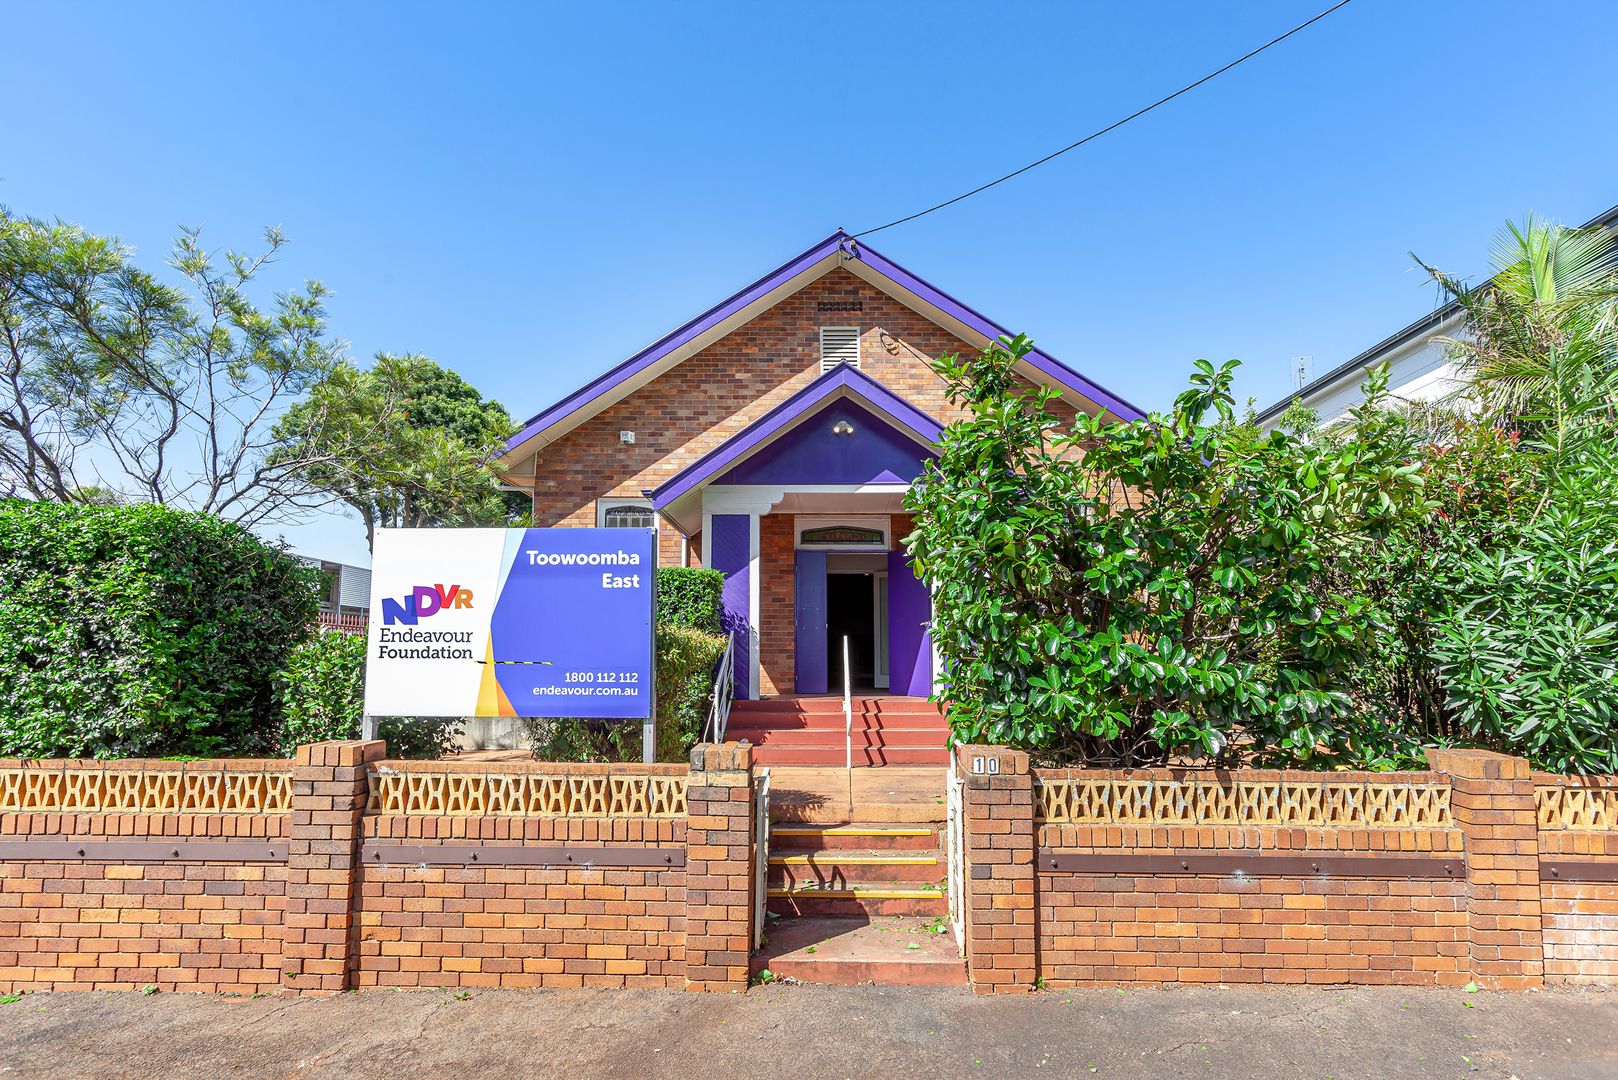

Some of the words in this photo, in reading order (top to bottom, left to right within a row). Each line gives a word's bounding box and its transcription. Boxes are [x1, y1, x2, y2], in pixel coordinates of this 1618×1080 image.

[525, 549, 640, 565] Toowoomba
[602, 573, 640, 588] East
[381, 583, 474, 625] NDVR
[379, 628, 473, 642] Endeavour
[378, 646, 473, 659] Foundation
[565, 672, 594, 683] 1800
[596, 672, 616, 683] 112
[619, 672, 639, 683] 112
[532, 685, 639, 696] endeavour.com.au
[976, 758, 997, 773] 10
